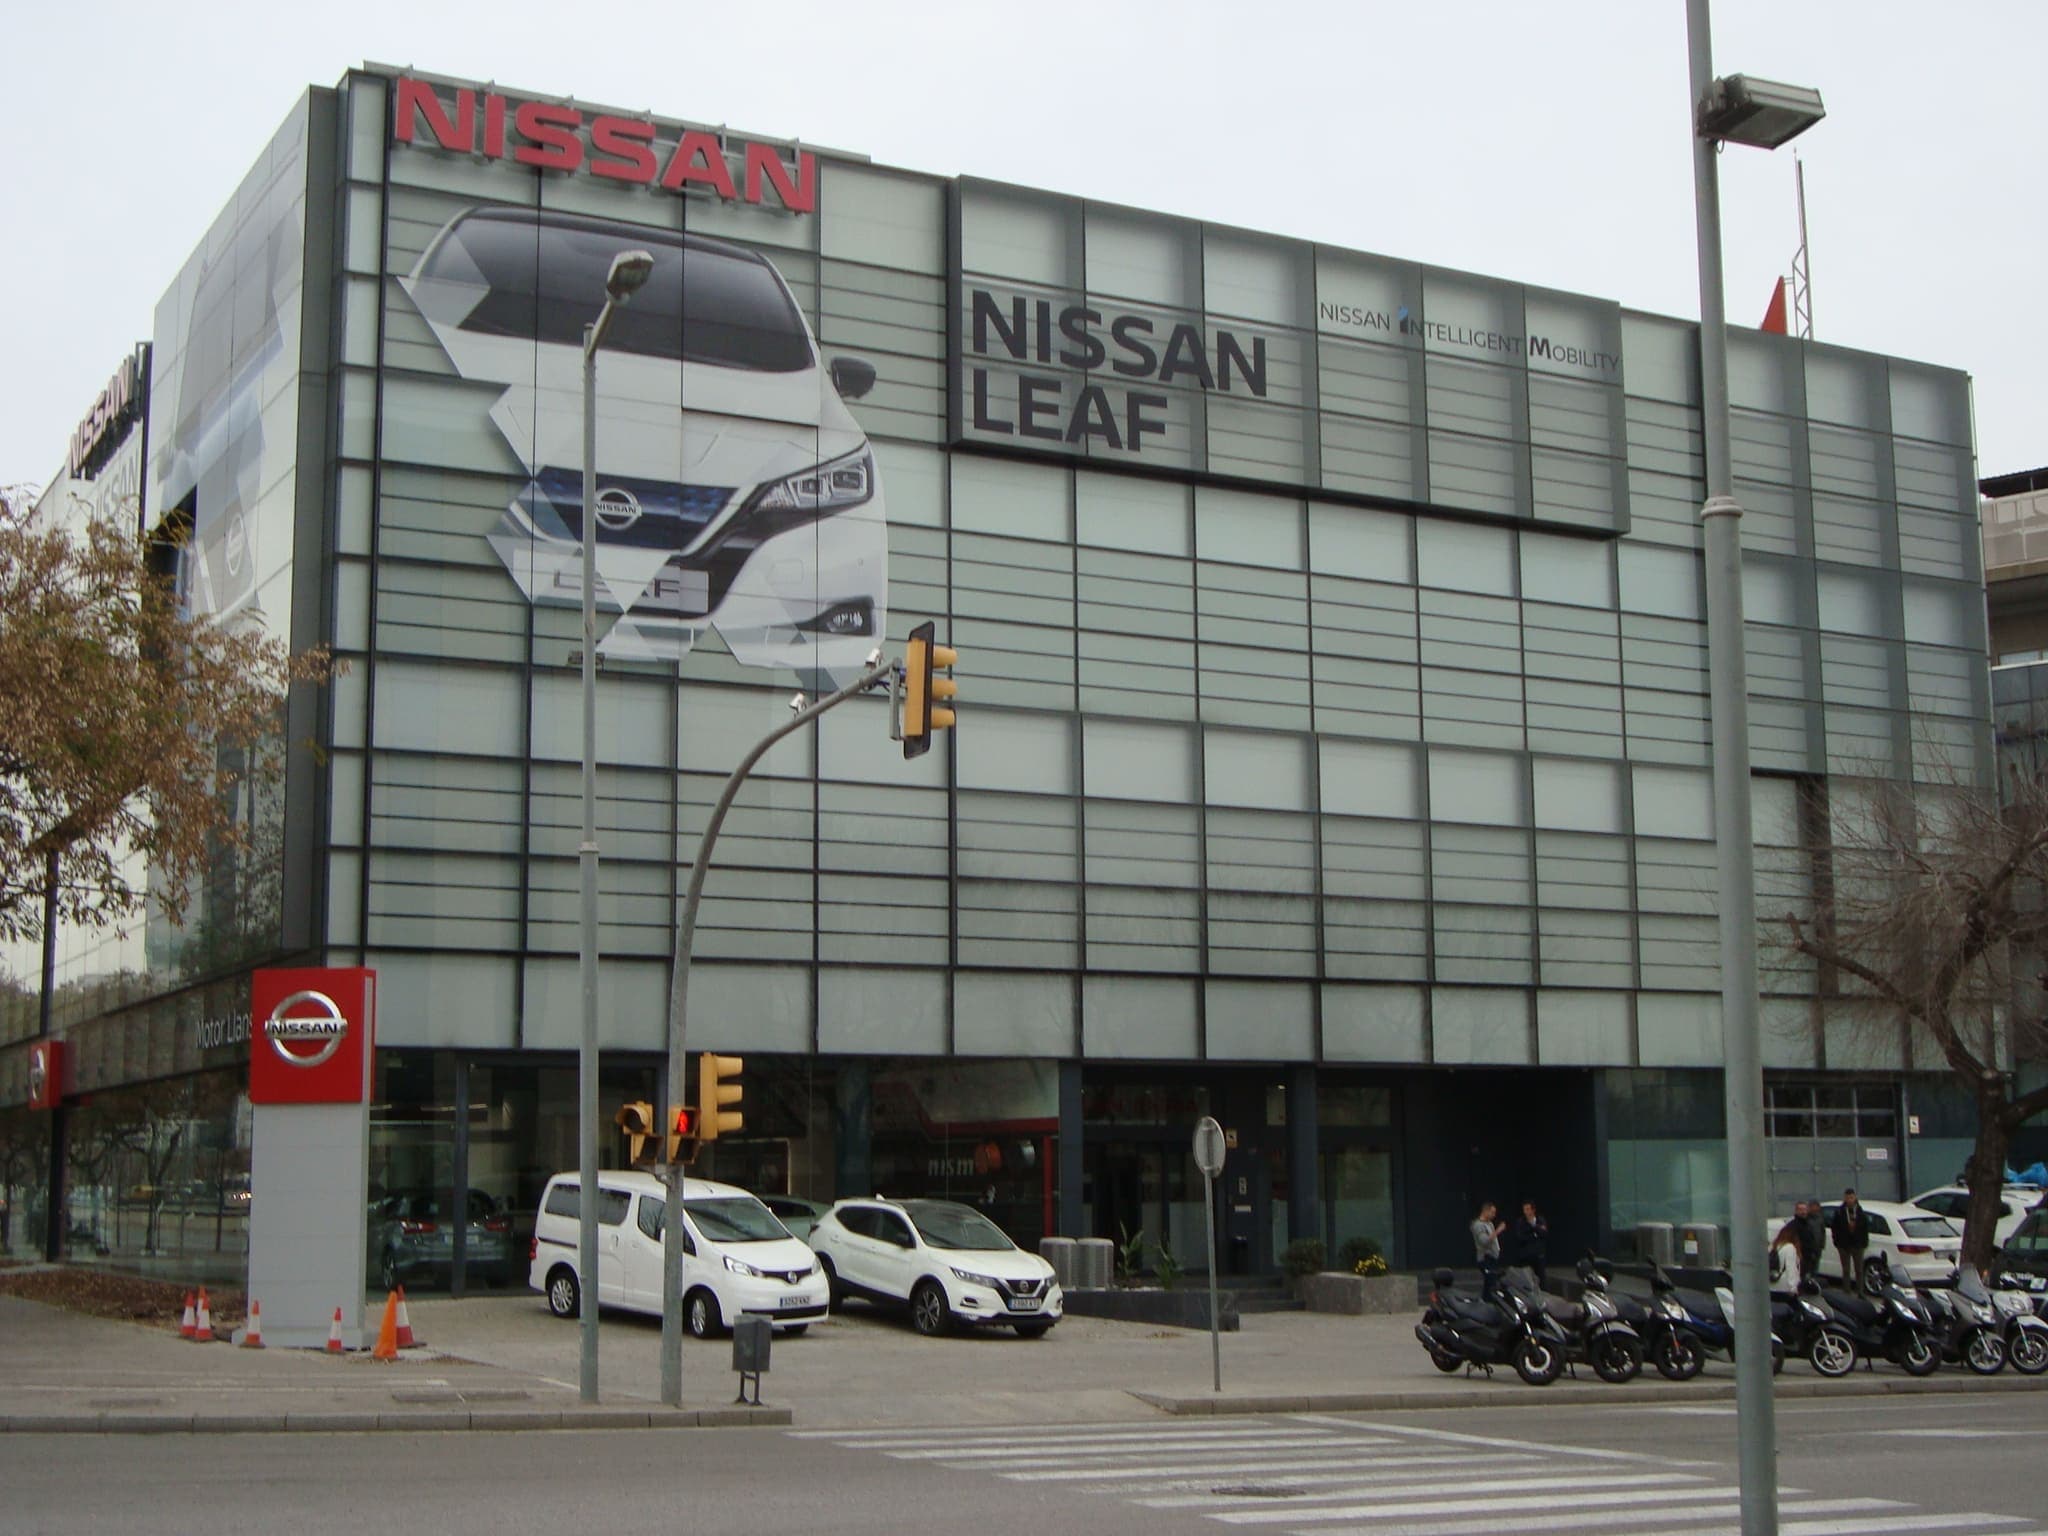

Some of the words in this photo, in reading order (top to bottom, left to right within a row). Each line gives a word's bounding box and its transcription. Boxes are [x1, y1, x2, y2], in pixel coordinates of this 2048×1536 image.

[395, 77, 816, 213] NISSAN
[972, 289, 1267, 397] NISSAN
[1320, 302, 1391, 331] NISSAN
[70, 355, 134, 472] NISSAN
[972, 368, 1168, 452] LEAF
[594, 503, 638, 513] NISSAN
[195, 1017, 225, 1049] Motor
[271, 1022, 337, 1035] NISSAN
